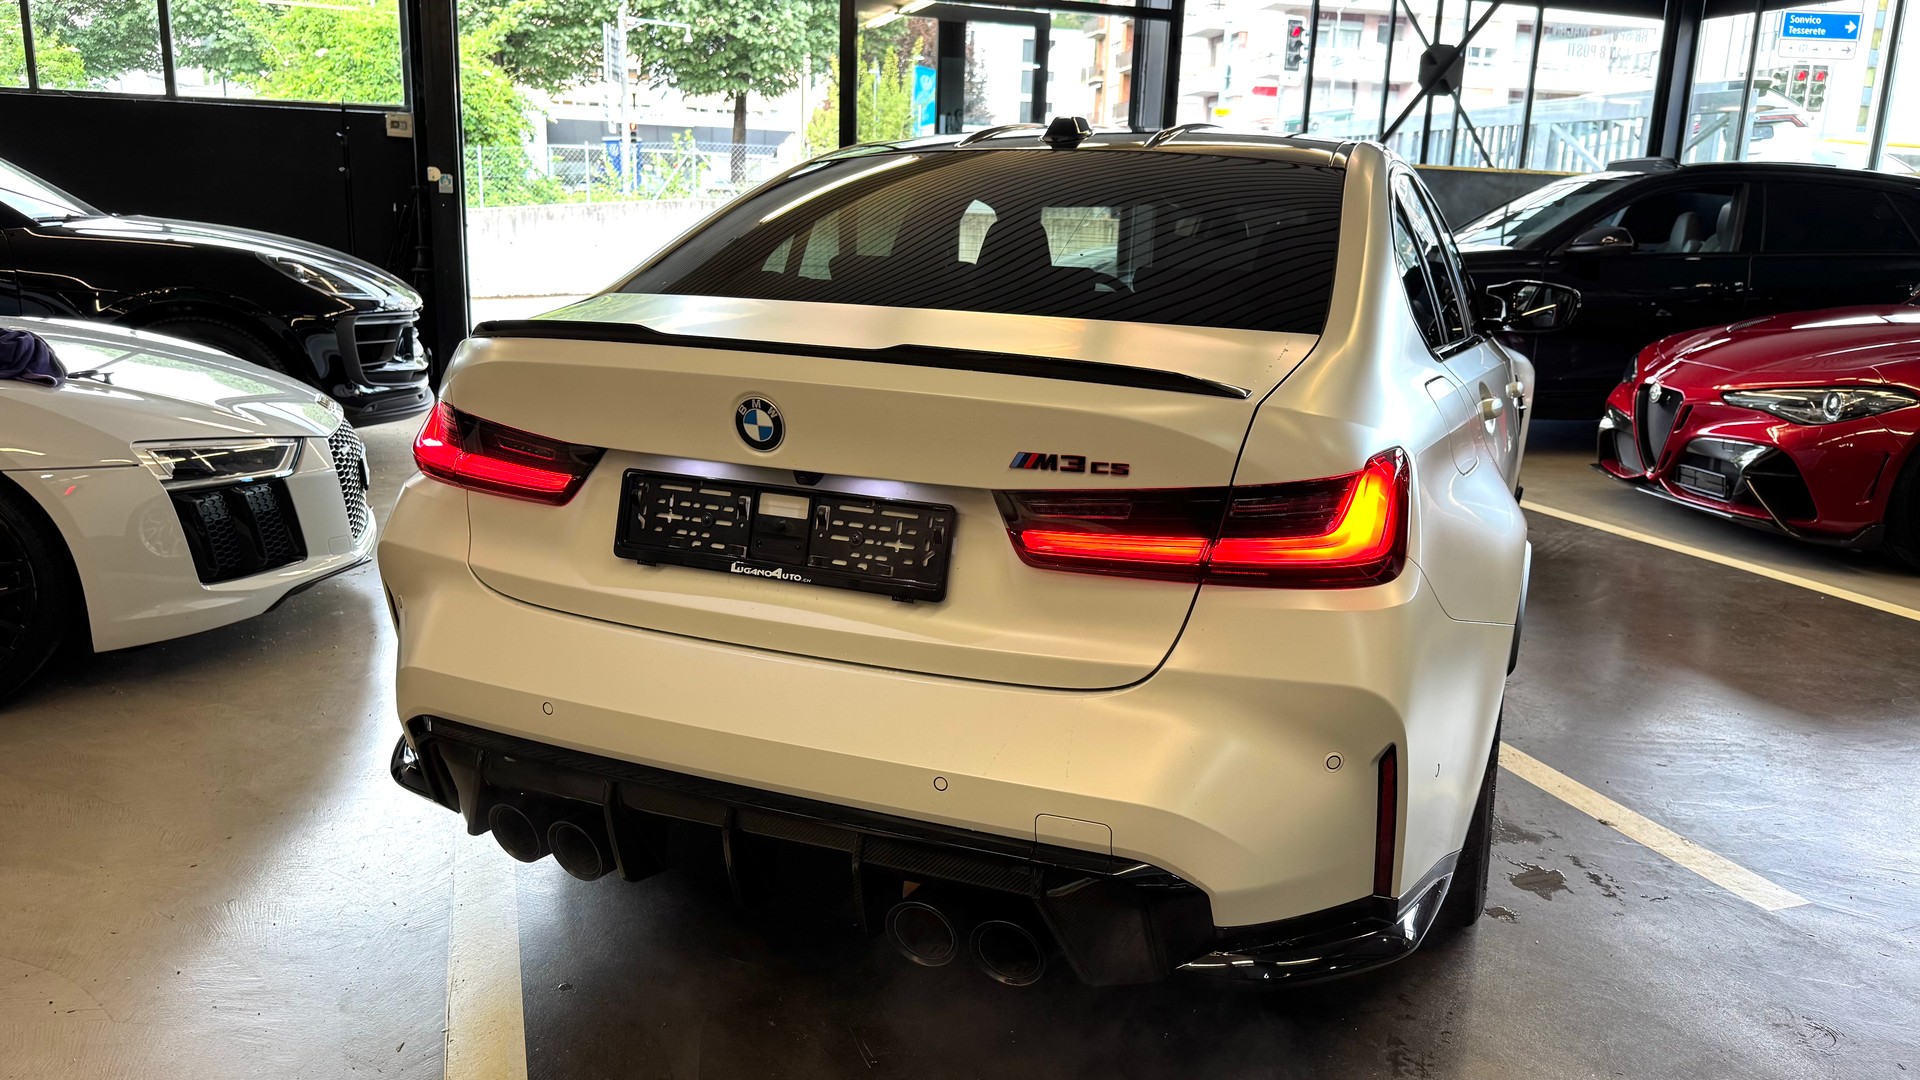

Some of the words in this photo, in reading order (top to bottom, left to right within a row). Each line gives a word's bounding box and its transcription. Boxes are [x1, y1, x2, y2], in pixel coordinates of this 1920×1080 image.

[1790, 15, 1822, 24] Sonvico
[1788, 25, 1827, 36] Tesserete
[738, 399, 778, 419] BMW
[1029, 452, 1086, 473] M3
[1090, 461, 1130, 476] CS
